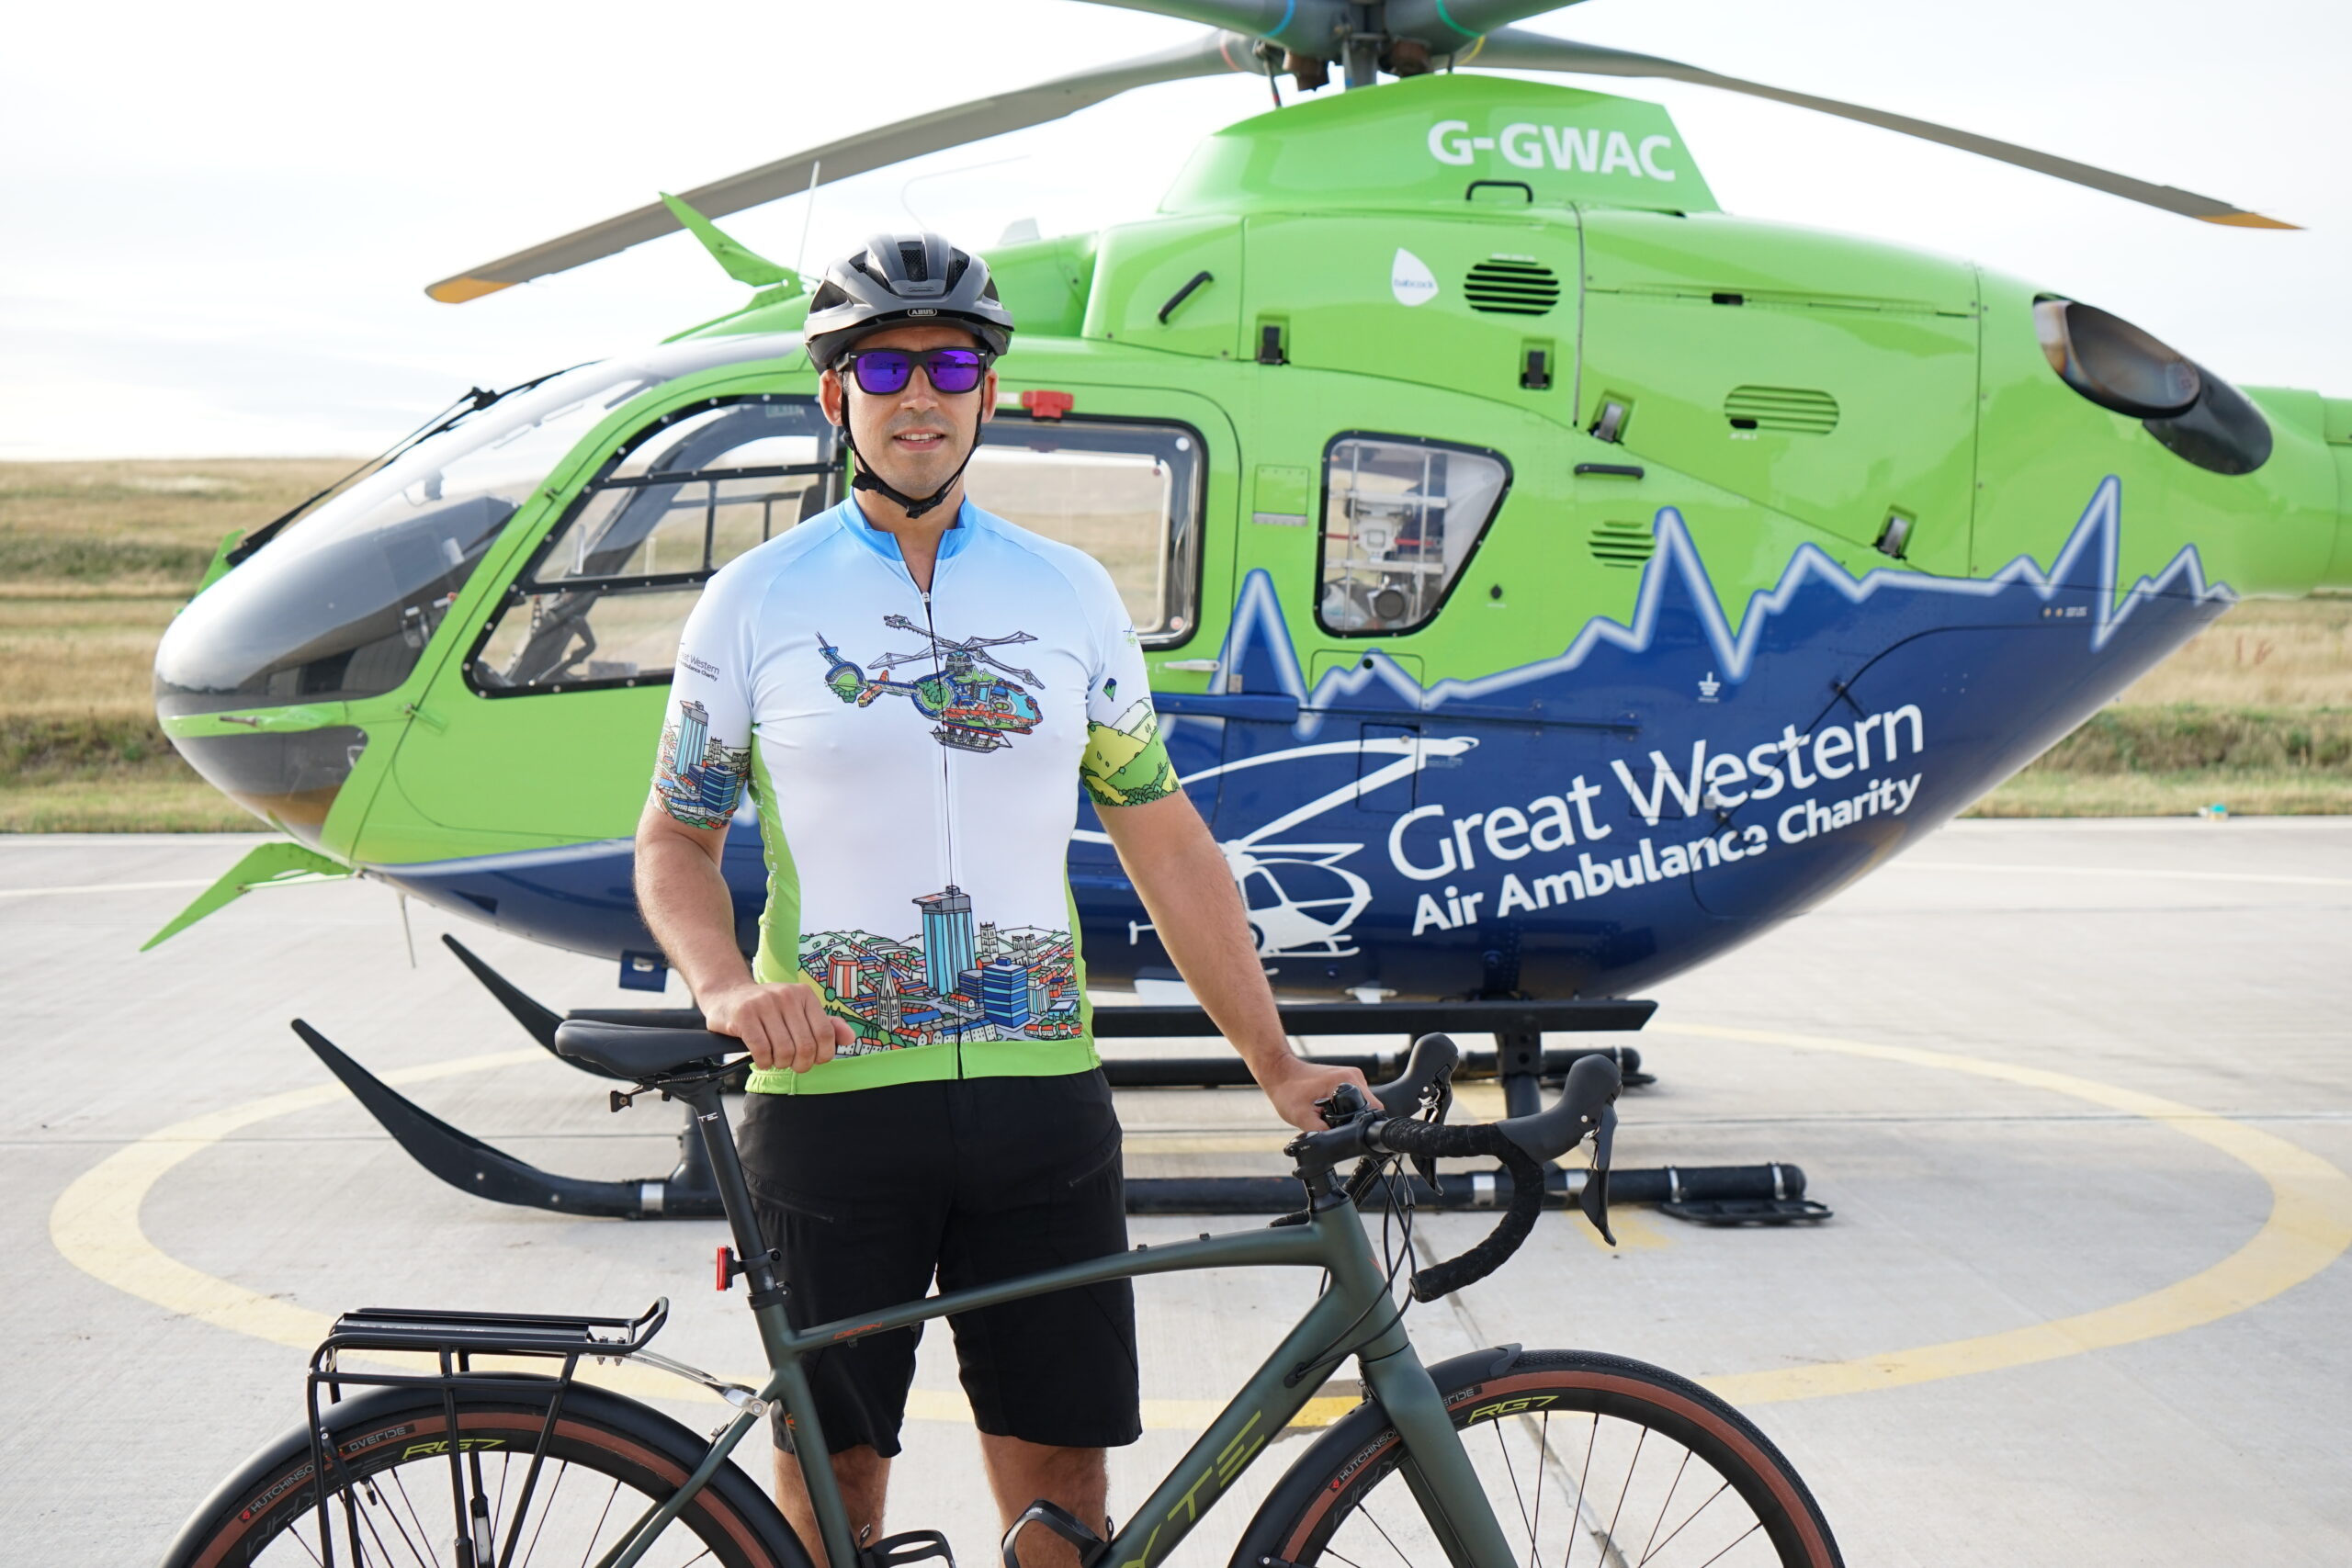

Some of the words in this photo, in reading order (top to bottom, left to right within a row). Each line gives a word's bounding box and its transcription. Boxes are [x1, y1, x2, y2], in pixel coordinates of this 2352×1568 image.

[1428, 120, 1676, 181] G-GWAC
[691, 655, 719, 675] Western
[1388, 775, 1611, 881] Great
[1611, 704, 1924, 826] Western
[1412, 886, 1484, 937] Air
[1497, 825, 1768, 918] Ambulance
[1778, 773, 1922, 843] Charity
[1468, 1395, 1560, 1424] RG7
[401, 1438, 507, 1461] RG7
[251, 1463, 316, 1513] HUTCHINSO
